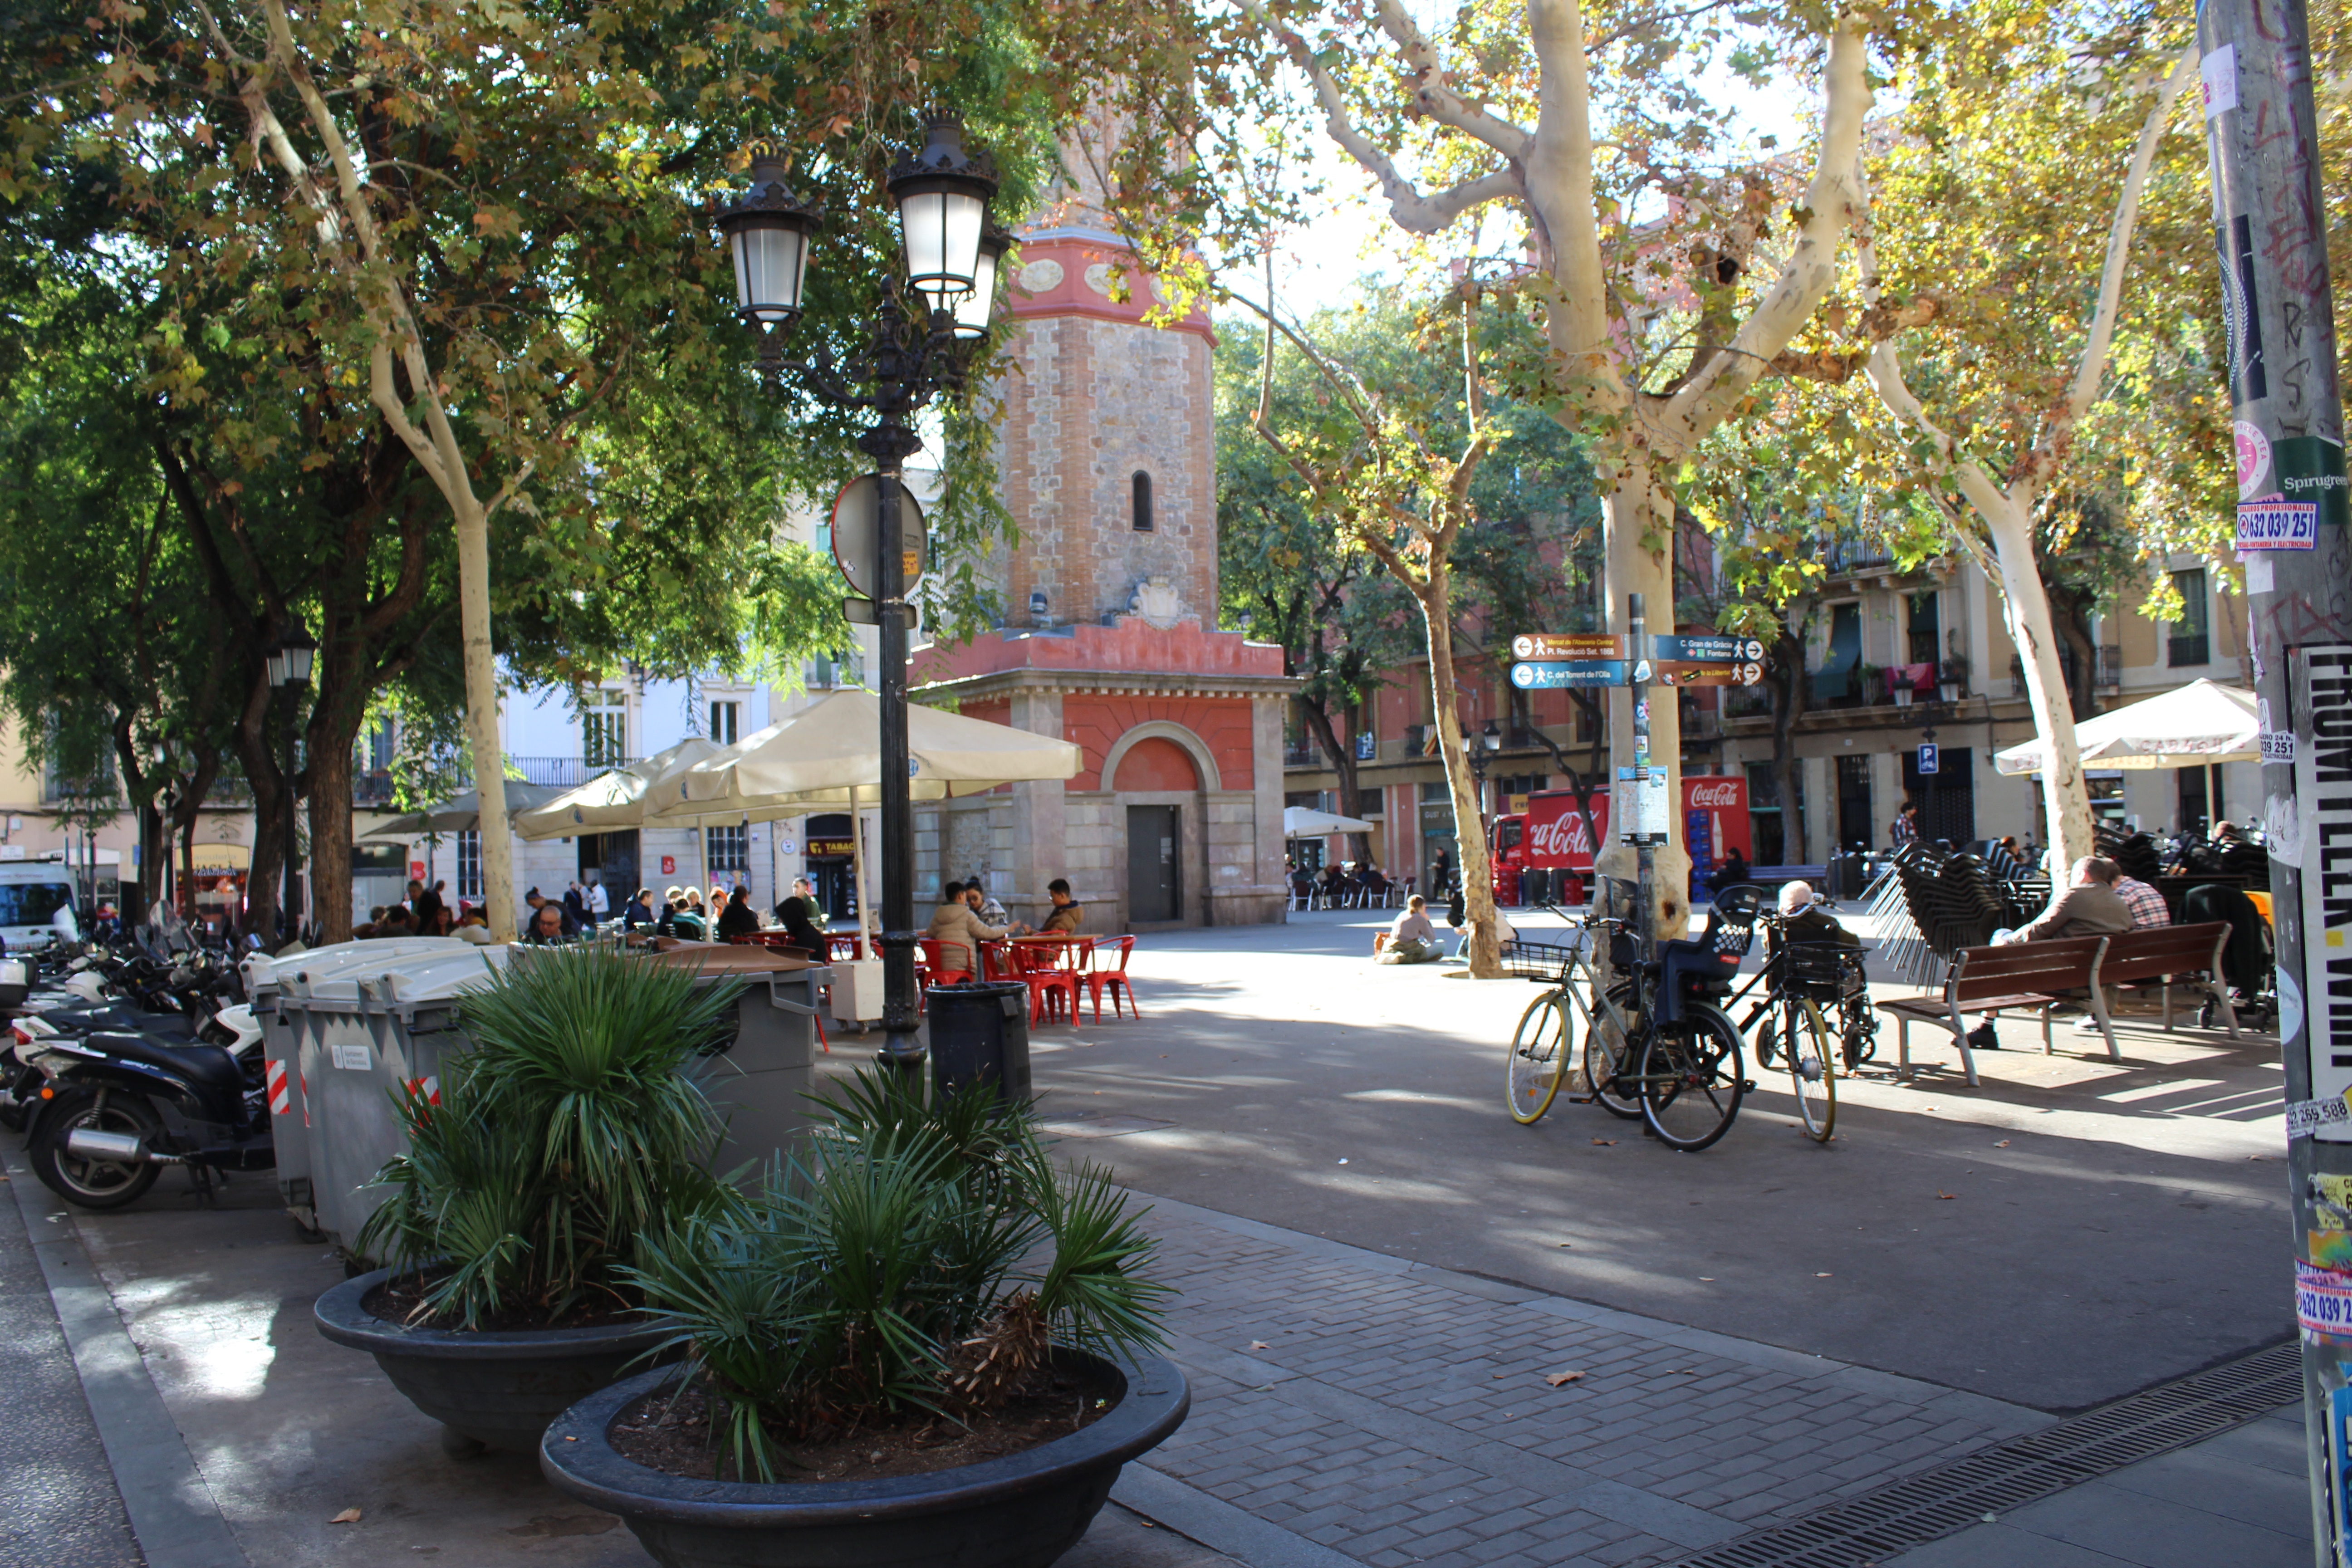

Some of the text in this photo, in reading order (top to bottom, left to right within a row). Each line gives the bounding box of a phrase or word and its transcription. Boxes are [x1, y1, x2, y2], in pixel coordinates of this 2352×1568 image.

[2235, 422, 2268, 460] UBBLE TEA
[2241, 485, 2252, 497] CIA
[2284, 474, 2348, 492] Spirugreen
[2261, 504, 2314, 512] PROFESIONALES
[2249, 513, 2313, 538] 632 039 251
[1924, 748, 1932, 760] P
[2274, 742, 2293, 754] 251
[2298, 1107, 2319, 1122] 269
[2322, 1102, 2347, 1118] 588
[2302, 1291, 2317, 1318] 632
[2318, 1295, 2340, 1323] 039
